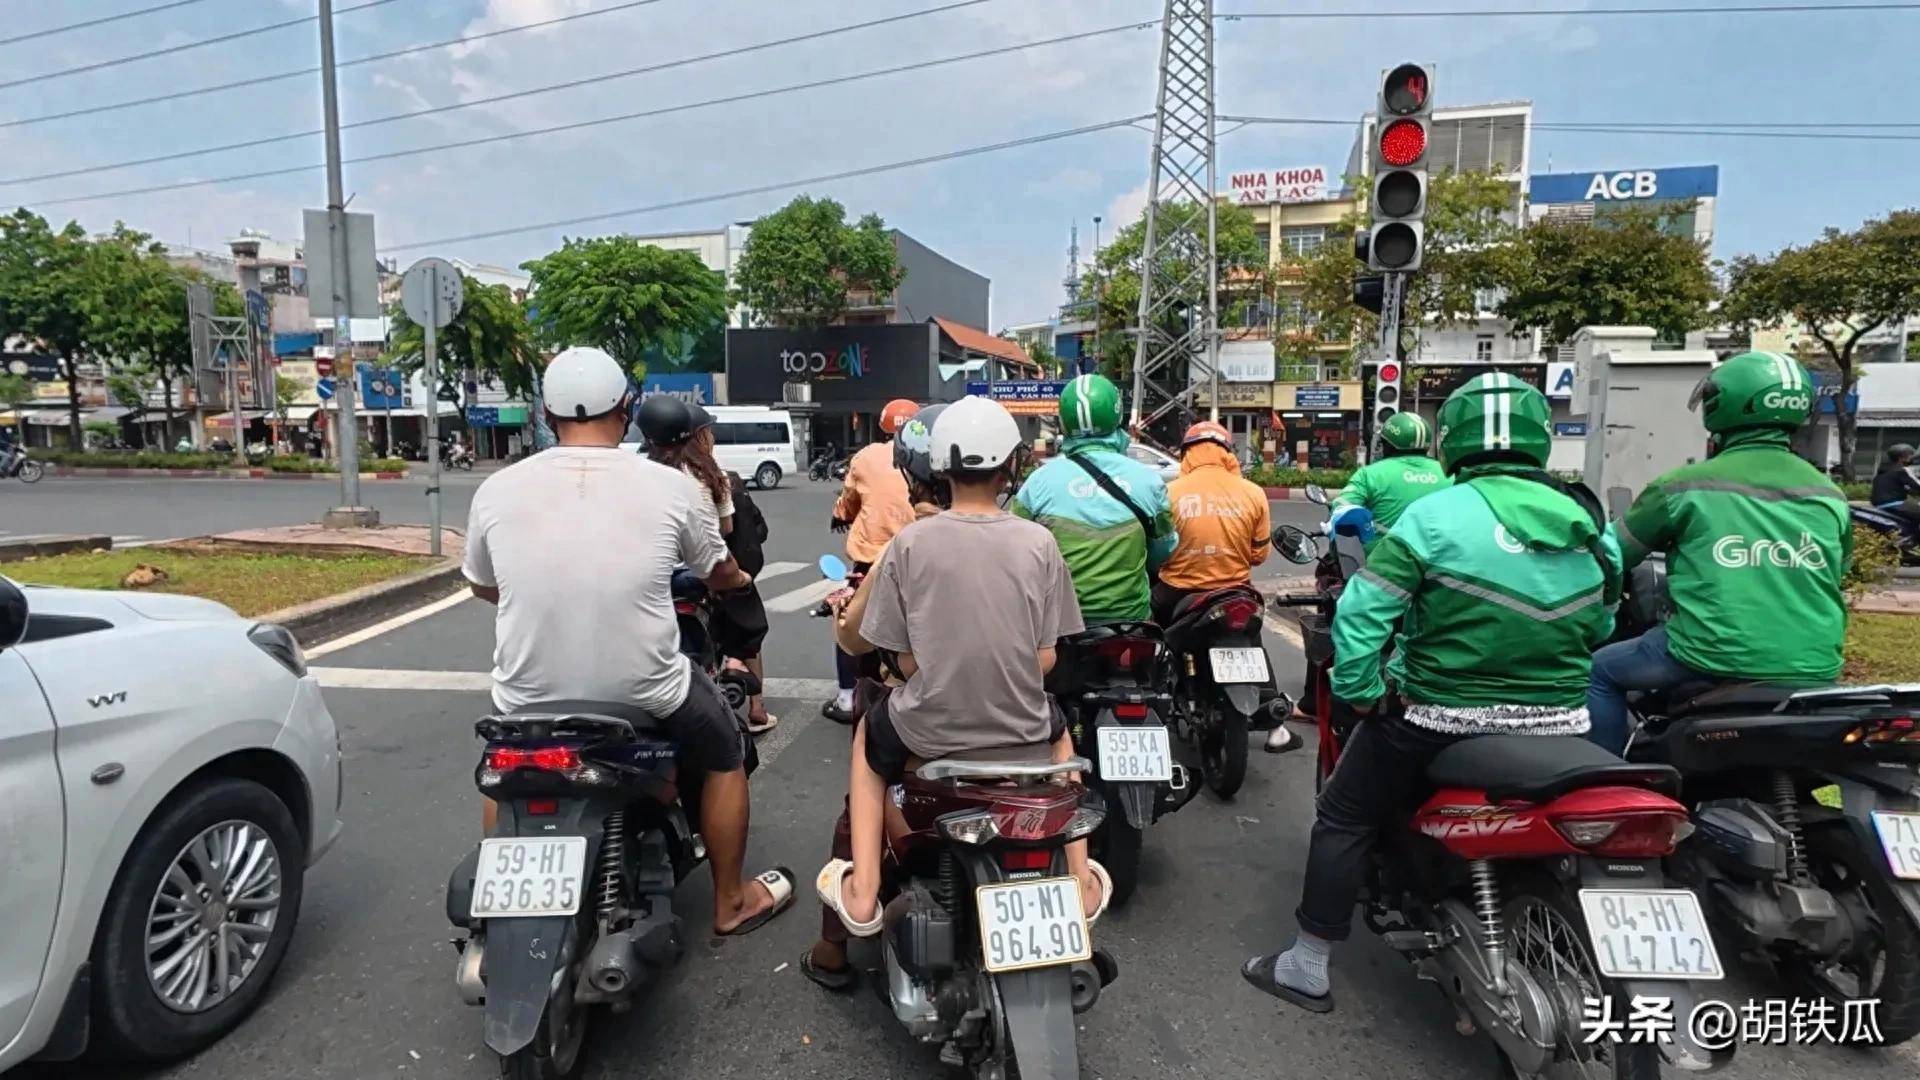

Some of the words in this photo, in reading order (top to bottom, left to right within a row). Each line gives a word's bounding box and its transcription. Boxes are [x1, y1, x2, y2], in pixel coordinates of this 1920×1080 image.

[1232, 173, 1267, 189] NHA
[1275, 168, 1324, 186] KHOA
[1584, 170, 1657, 200] ACB
[1239, 189, 1266, 201] AN
[1763, 391, 1809, 410] Grab
[1403, 470, 1439, 485] Grab
[1712, 531, 1828, 570] Grab
[1108, 732, 1158, 753] 59-KA
[1106, 755, 1164, 777] 188.41
[496, 843, 566, 875] 59-H1
[1608, 864, 1644, 872] HONDA
[1009, 871, 1041, 879] HONDA
[481, 876, 576, 912] 636.35
[993, 884, 1065, 924] 50-N1
[1600, 896, 1684, 932] 84-H1
[989, 920, 1083, 964] 964.90
[1600, 934, 1713, 972] 147.42
